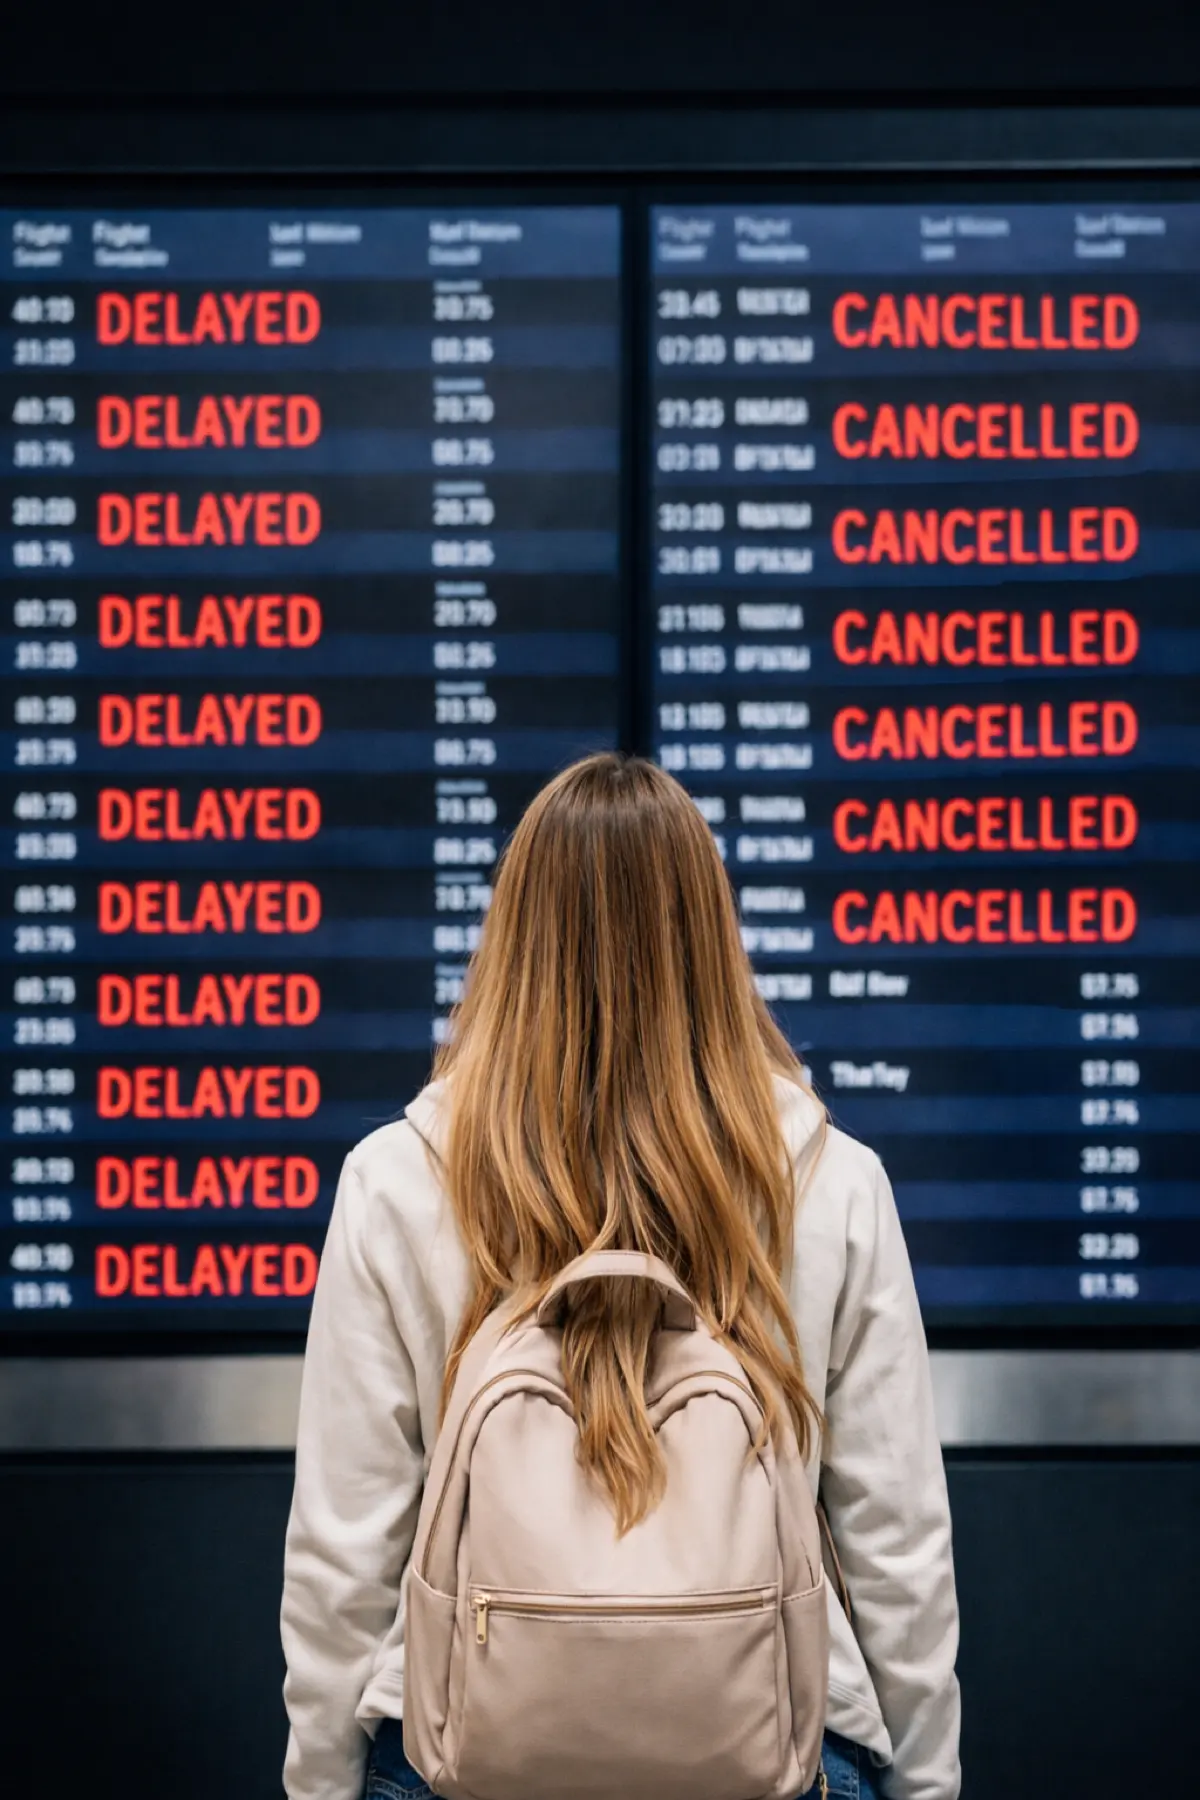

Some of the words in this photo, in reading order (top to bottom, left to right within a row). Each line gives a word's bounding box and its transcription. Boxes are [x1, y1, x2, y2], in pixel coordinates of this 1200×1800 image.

[98, 292, 320, 344] DELAYED
[833, 293, 1138, 349] CANCELLED
[98, 395, 320, 448] DELAYED
[833, 403, 1138, 458] CANCELLED
[99, 493, 320, 545] DELAYED
[832, 508, 1138, 564] CANCELLED
[100, 595, 321, 647] DELAYED
[833, 611, 1138, 665] CANCELLED
[100, 694, 321, 746] DELAYED
[833, 702, 1137, 760] CANCELLED
[99, 789, 320, 840] DELAYED
[834, 796, 1137, 852] CANCELLED
[100, 882, 320, 933] DELAYED
[833, 889, 1136, 944] CANCELLED
[99, 974, 320, 1026] DELAYED
[98, 1067, 320, 1118] DELAYED
[97, 1157, 318, 1208] DELAYED
[96, 1244, 318, 1296] DELAYED
